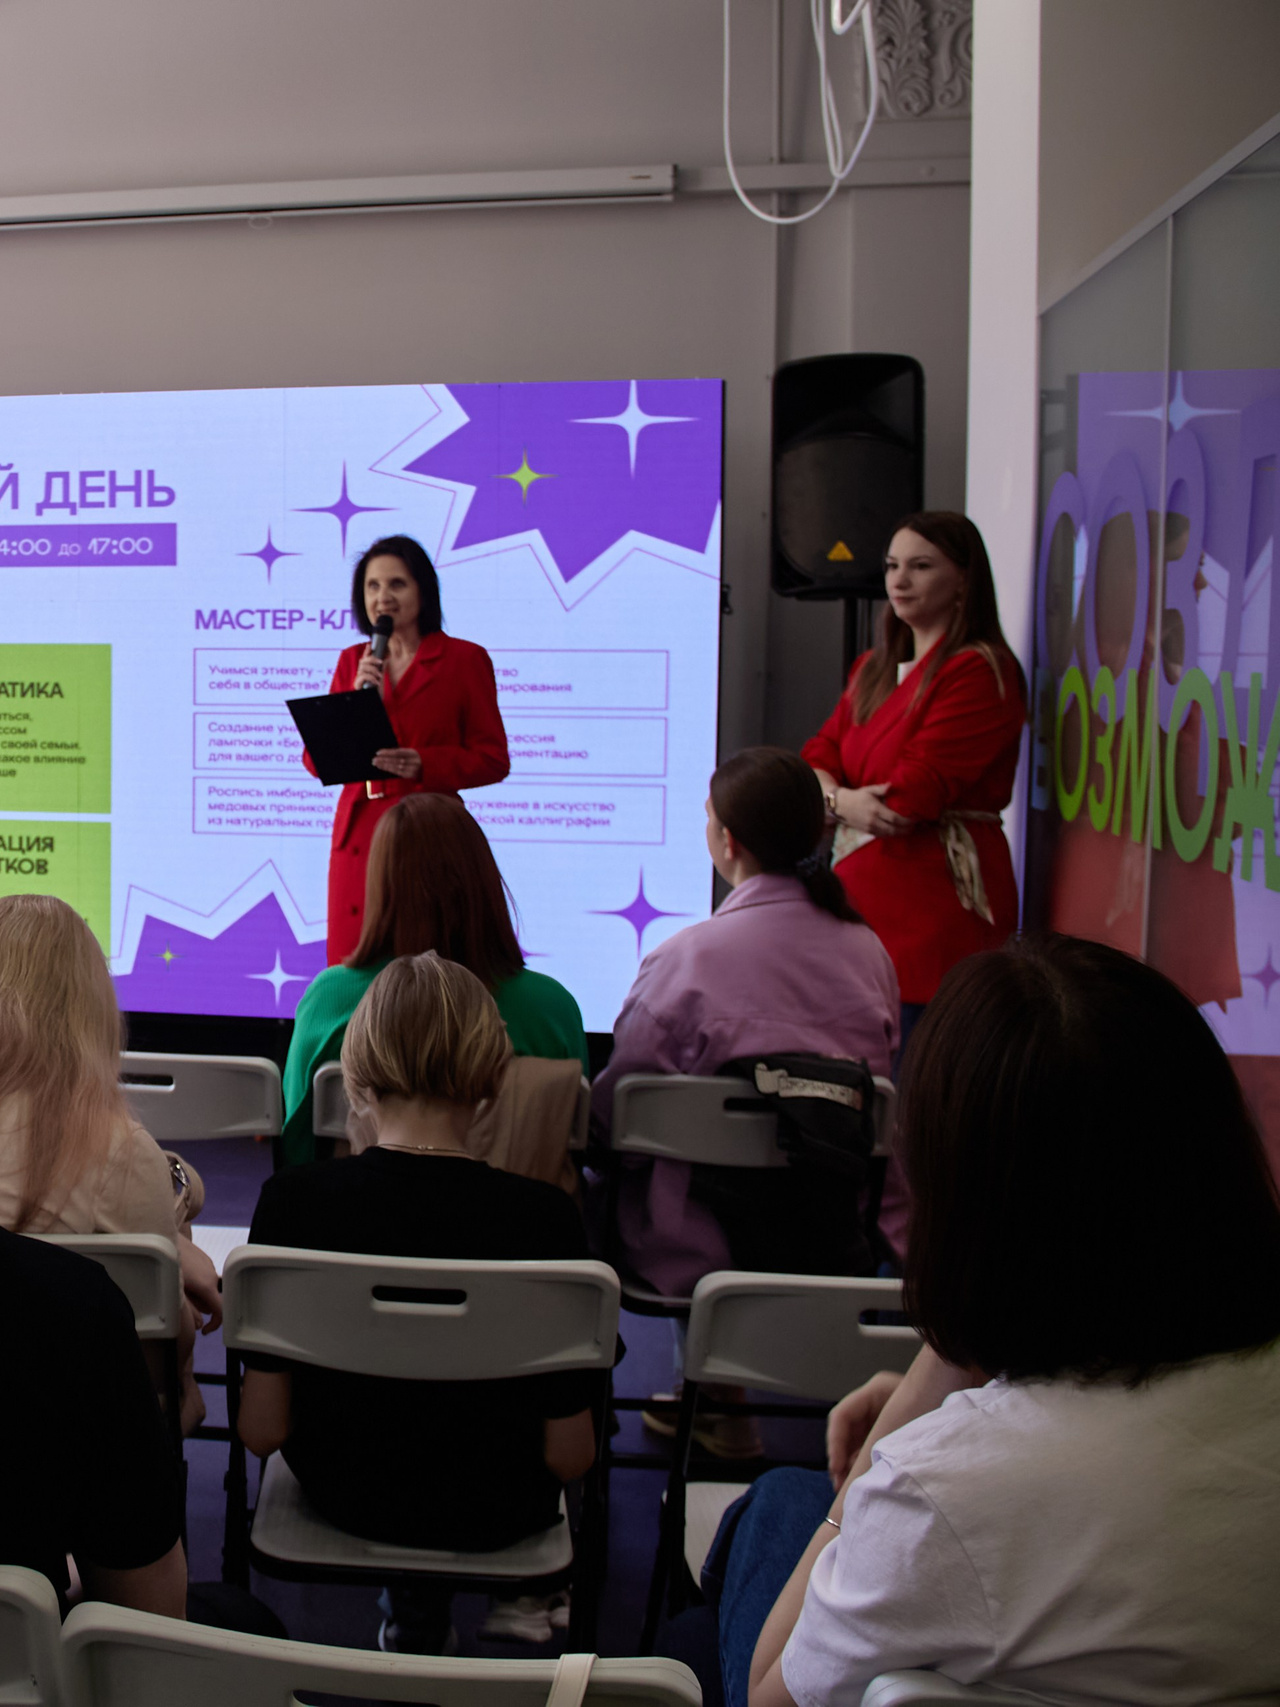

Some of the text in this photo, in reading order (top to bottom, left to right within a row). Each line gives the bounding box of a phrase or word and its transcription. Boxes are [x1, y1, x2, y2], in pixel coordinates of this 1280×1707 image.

[36, 469, 176, 515] ДЕНЬ
[58, 542, 81, 558] до
[88, 537, 153, 556] 17:00
[194, 609, 358, 630] МАСТЕР-КЛ
[209, 665, 258, 675] Учимся
[261, 666, 313, 677] этикету
[209, 680, 327, 691] себя в обществе?
[497, 683, 572, 693] зирования
[208, 722, 298, 735] Создание уни
[0, 738, 37, 750] своей
[208, 738, 273, 748] лампочки
[33, 755, 86, 764] влияние
[208, 753, 232, 763] для
[236, 753, 283, 763] вашего
[509, 750, 589, 759] риентацию
[208, 786, 333, 799] Роспись имбирных
[208, 802, 333, 814] медовых пряников
[543, 803, 615, 812] искусство
[226, 817, 312, 828] натуральных
[518, 816, 610, 828] каллиграфии
